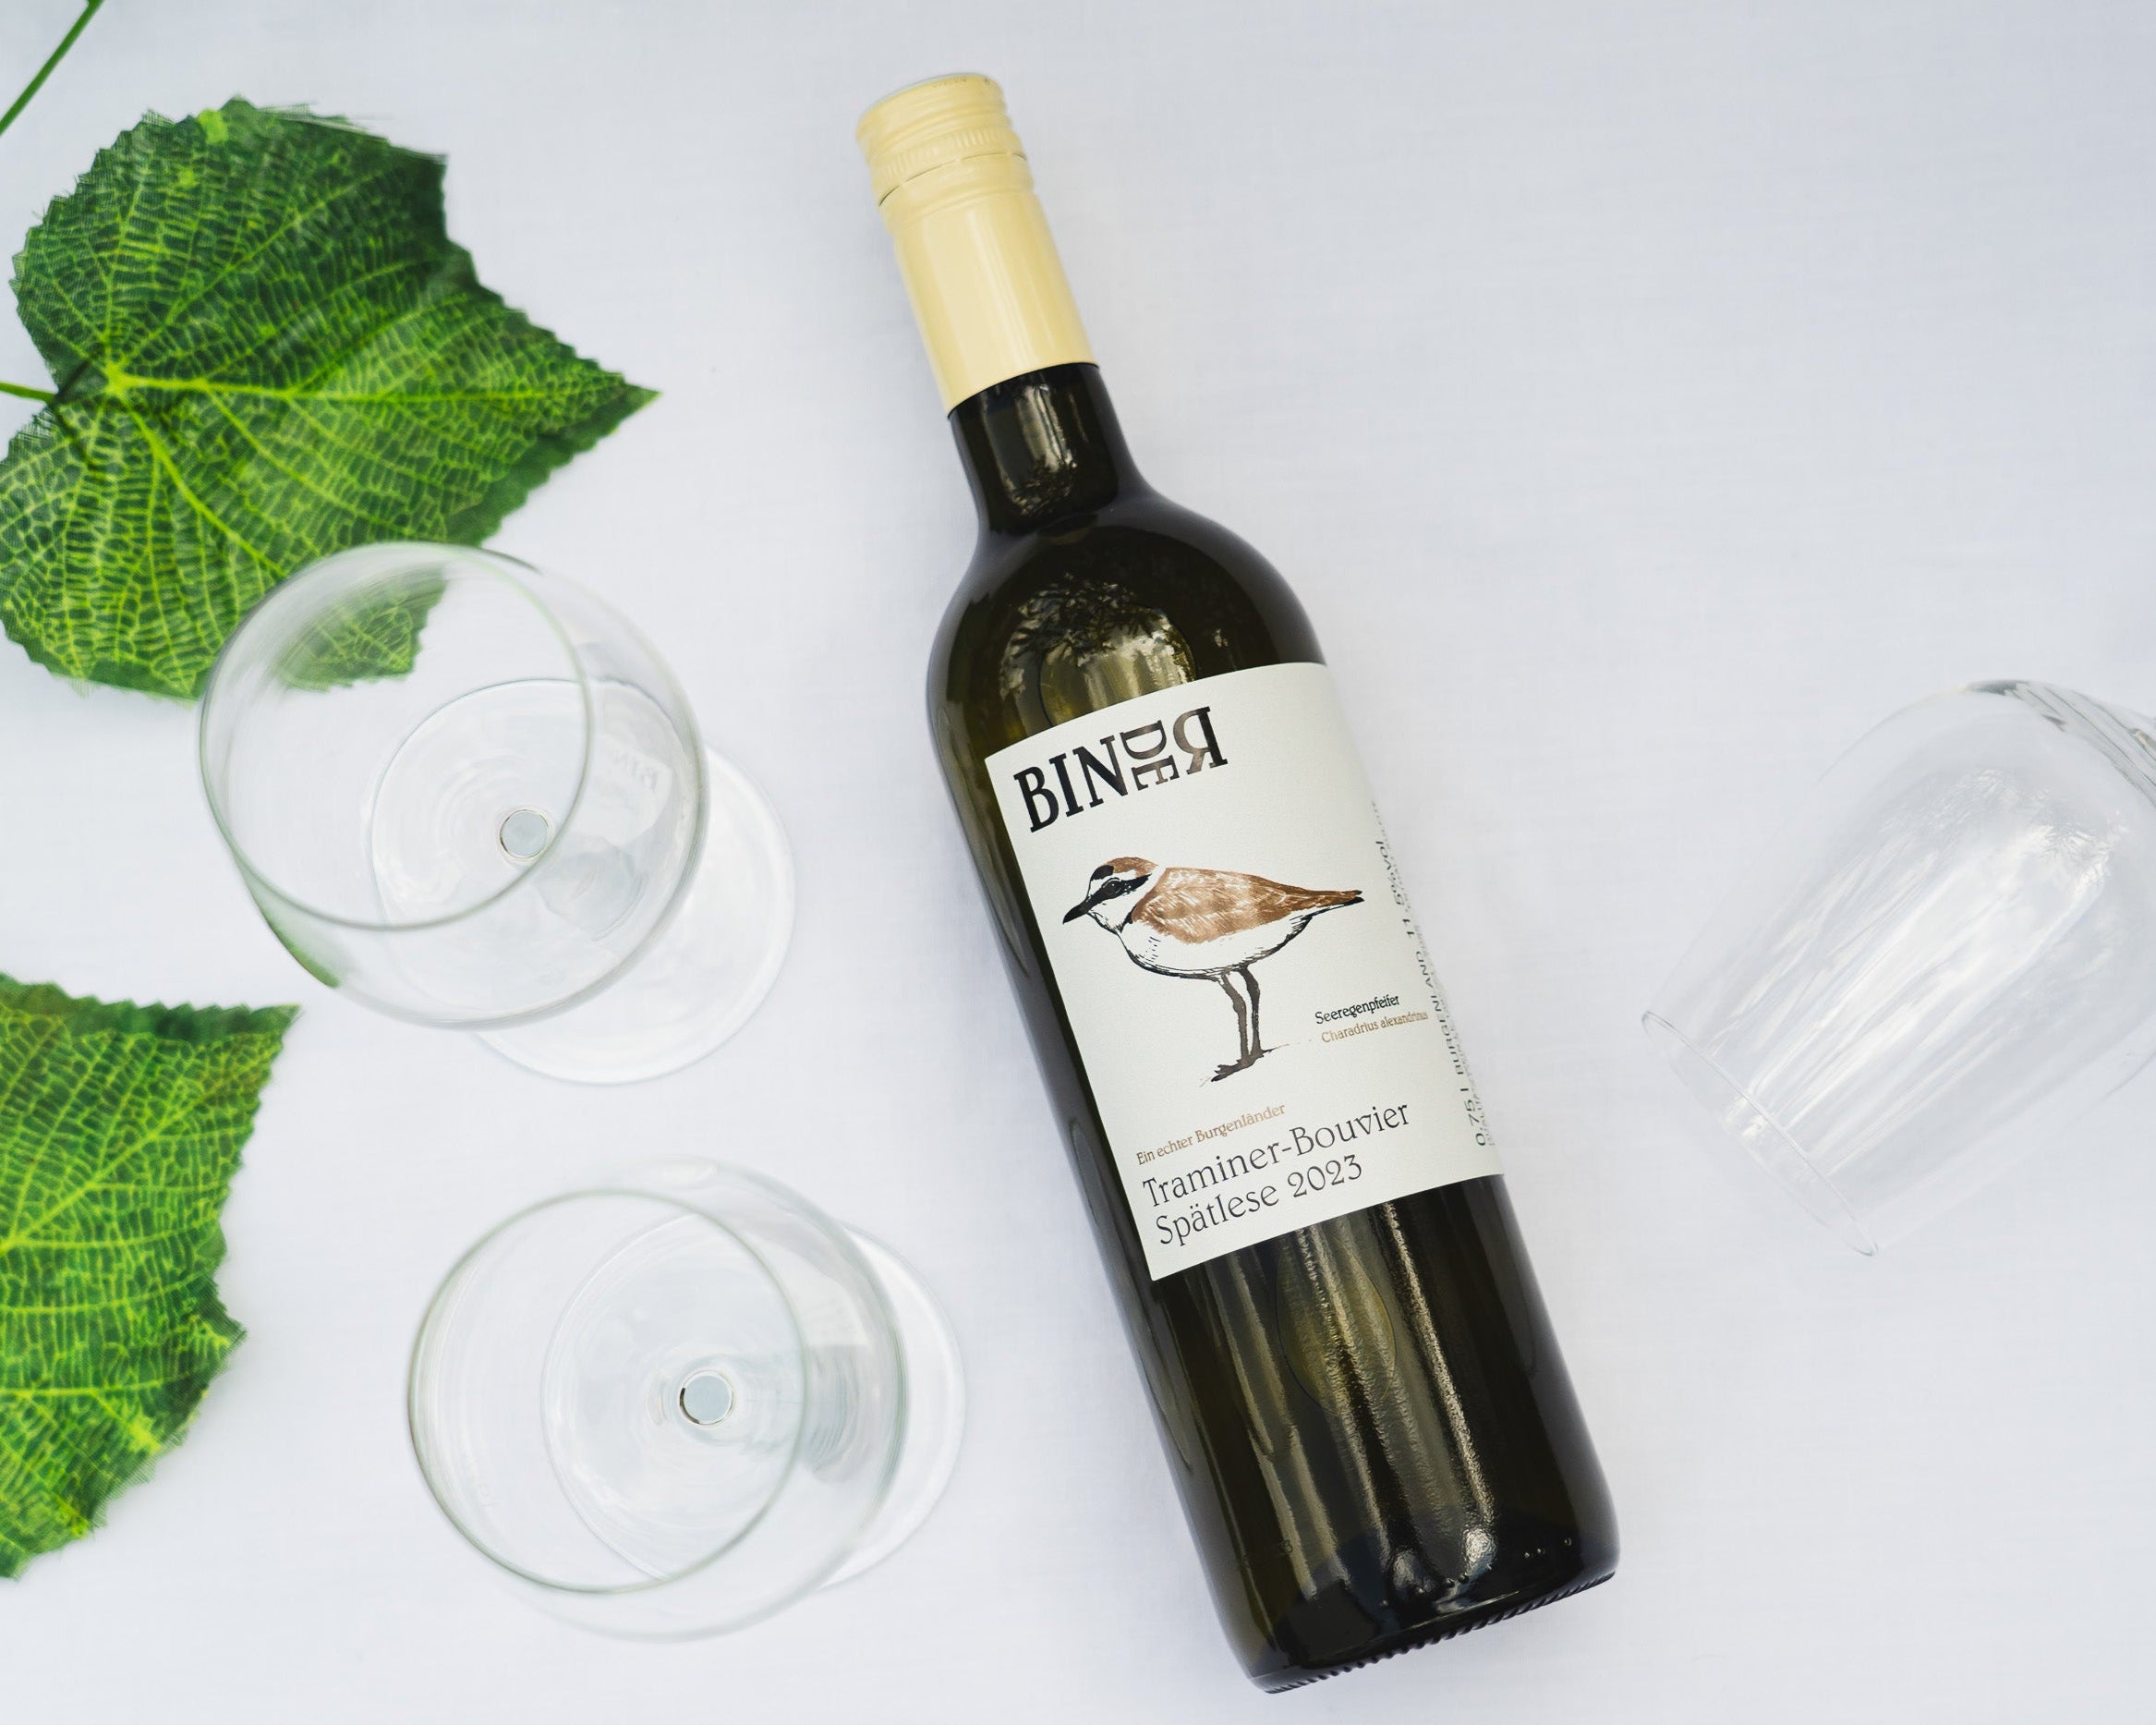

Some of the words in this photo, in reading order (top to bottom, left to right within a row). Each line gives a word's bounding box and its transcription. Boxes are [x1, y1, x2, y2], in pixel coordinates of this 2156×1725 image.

[1314, 994, 1399, 1024] Seeregenpfeifer
[1321, 1020, 1379, 1043] Charadrius
[1136, 1151, 1156, 1165] Ein
[1157, 1136, 1193, 1156] echter
[1195, 1104, 1285, 1142] Burgenländer
[1143, 1104, 1409, 1207] Traminer-Bouvier
[1156, 1184, 1279, 1246] Spätlese
[1288, 1154, 1363, 1197] 2023
